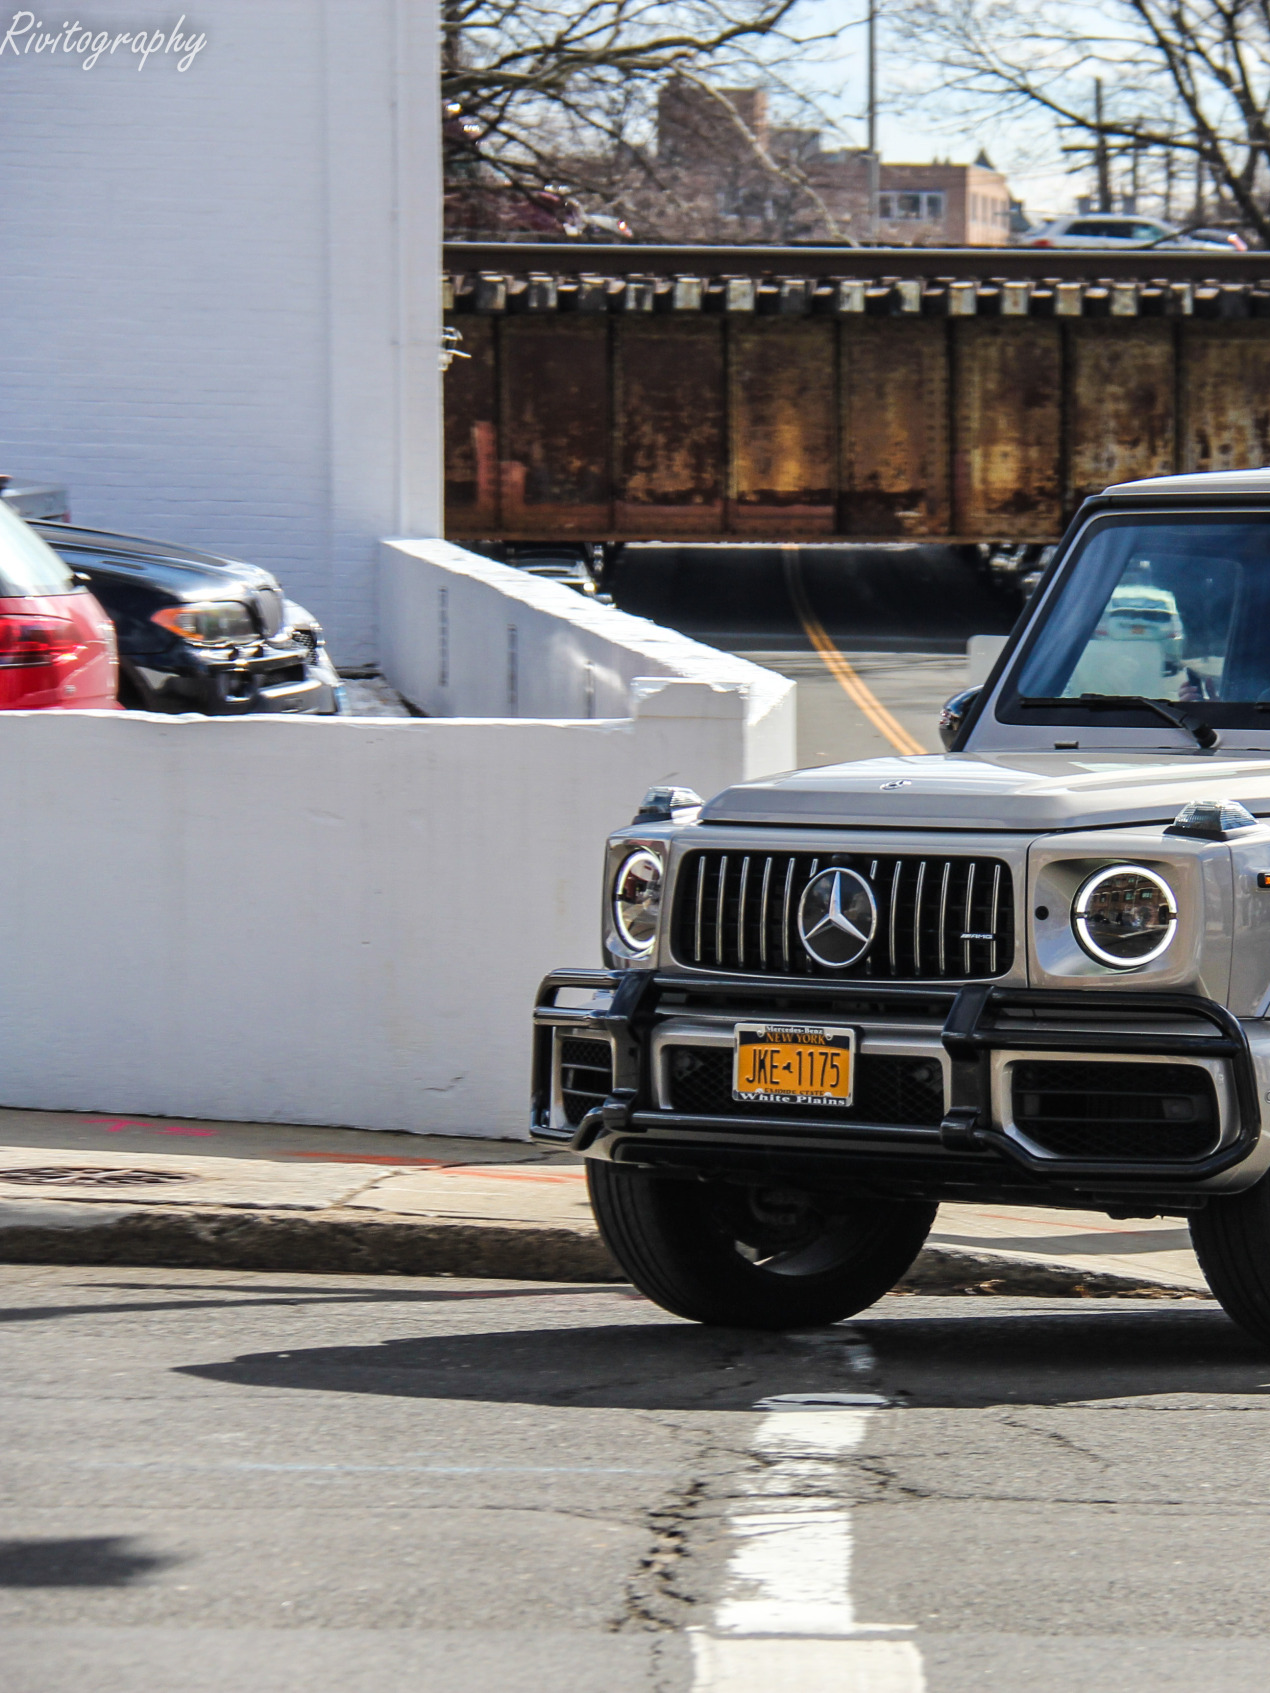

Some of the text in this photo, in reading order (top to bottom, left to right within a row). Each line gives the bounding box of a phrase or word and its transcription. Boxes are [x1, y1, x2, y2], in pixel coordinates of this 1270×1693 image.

[766, 1026, 824, 1035] Mercedes-Benz
[766, 1032, 826, 1045] NEW YORK
[740, 1092, 845, 1106] White Plains
